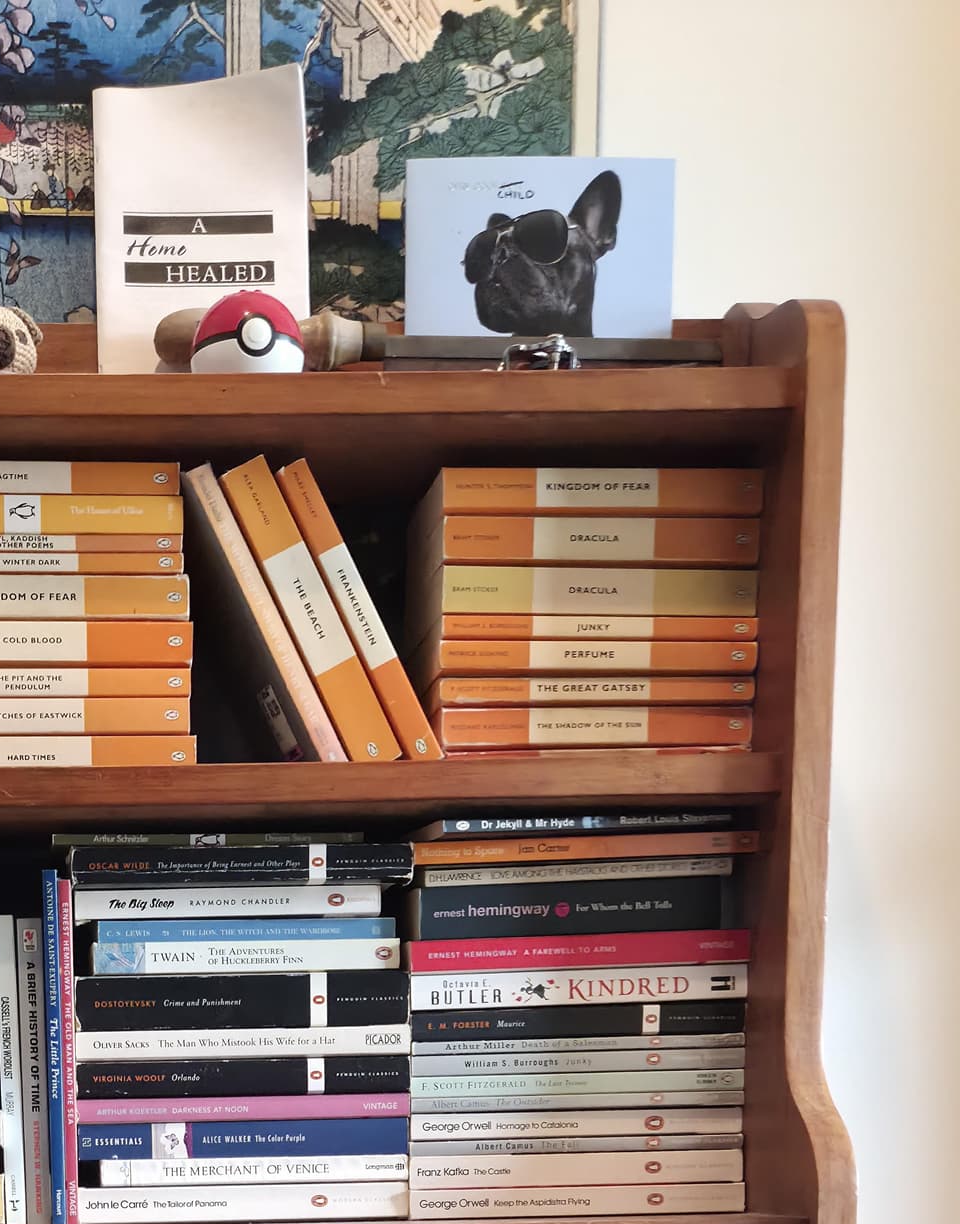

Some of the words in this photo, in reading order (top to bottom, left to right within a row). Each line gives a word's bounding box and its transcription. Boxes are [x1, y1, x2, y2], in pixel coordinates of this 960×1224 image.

[191, 218, 208, 234] A
[127, 237, 186, 258] Home
[165, 263, 267, 283] HEALED
[569, 534, 619, 542] DRACULA
[336, 568, 377, 646] FRANKENSTEIN
[577, 624, 611, 632] JUNKY
[564, 650, 615, 659] PERFUME
[537, 684, 559, 692] THE
[562, 684, 599, 692] GREAT
[602, 684, 645, 692] GATSBY
[468, 903, 550, 919] hemingway
[151, 952, 195, 963] TWAIN
[431, 988, 502, 1005] BUTLER
[94, 1000, 156, 1009] DOSTOYEVSKY
[28, 1007, 39, 1062] HISTORY
[365, 1033, 402, 1045] PICADOR
[135, 1074, 165, 1082] WOOLF
[171, 1073, 201, 1082] Orlando
[422, 1122, 460, 1132] George
[462, 1121, 492, 1131] Orwell
[95, 1137, 143, 1146] ESSENTIALS
[163, 1165, 186, 1177] THE
[190, 1164, 260, 1176] MERCHANT
[267, 1164, 282, 1175] OF
[286, 1164, 329, 1174] VENICE
[417, 1168, 441, 1177] Franz
[444, 1167, 469, 1176] Kafka
